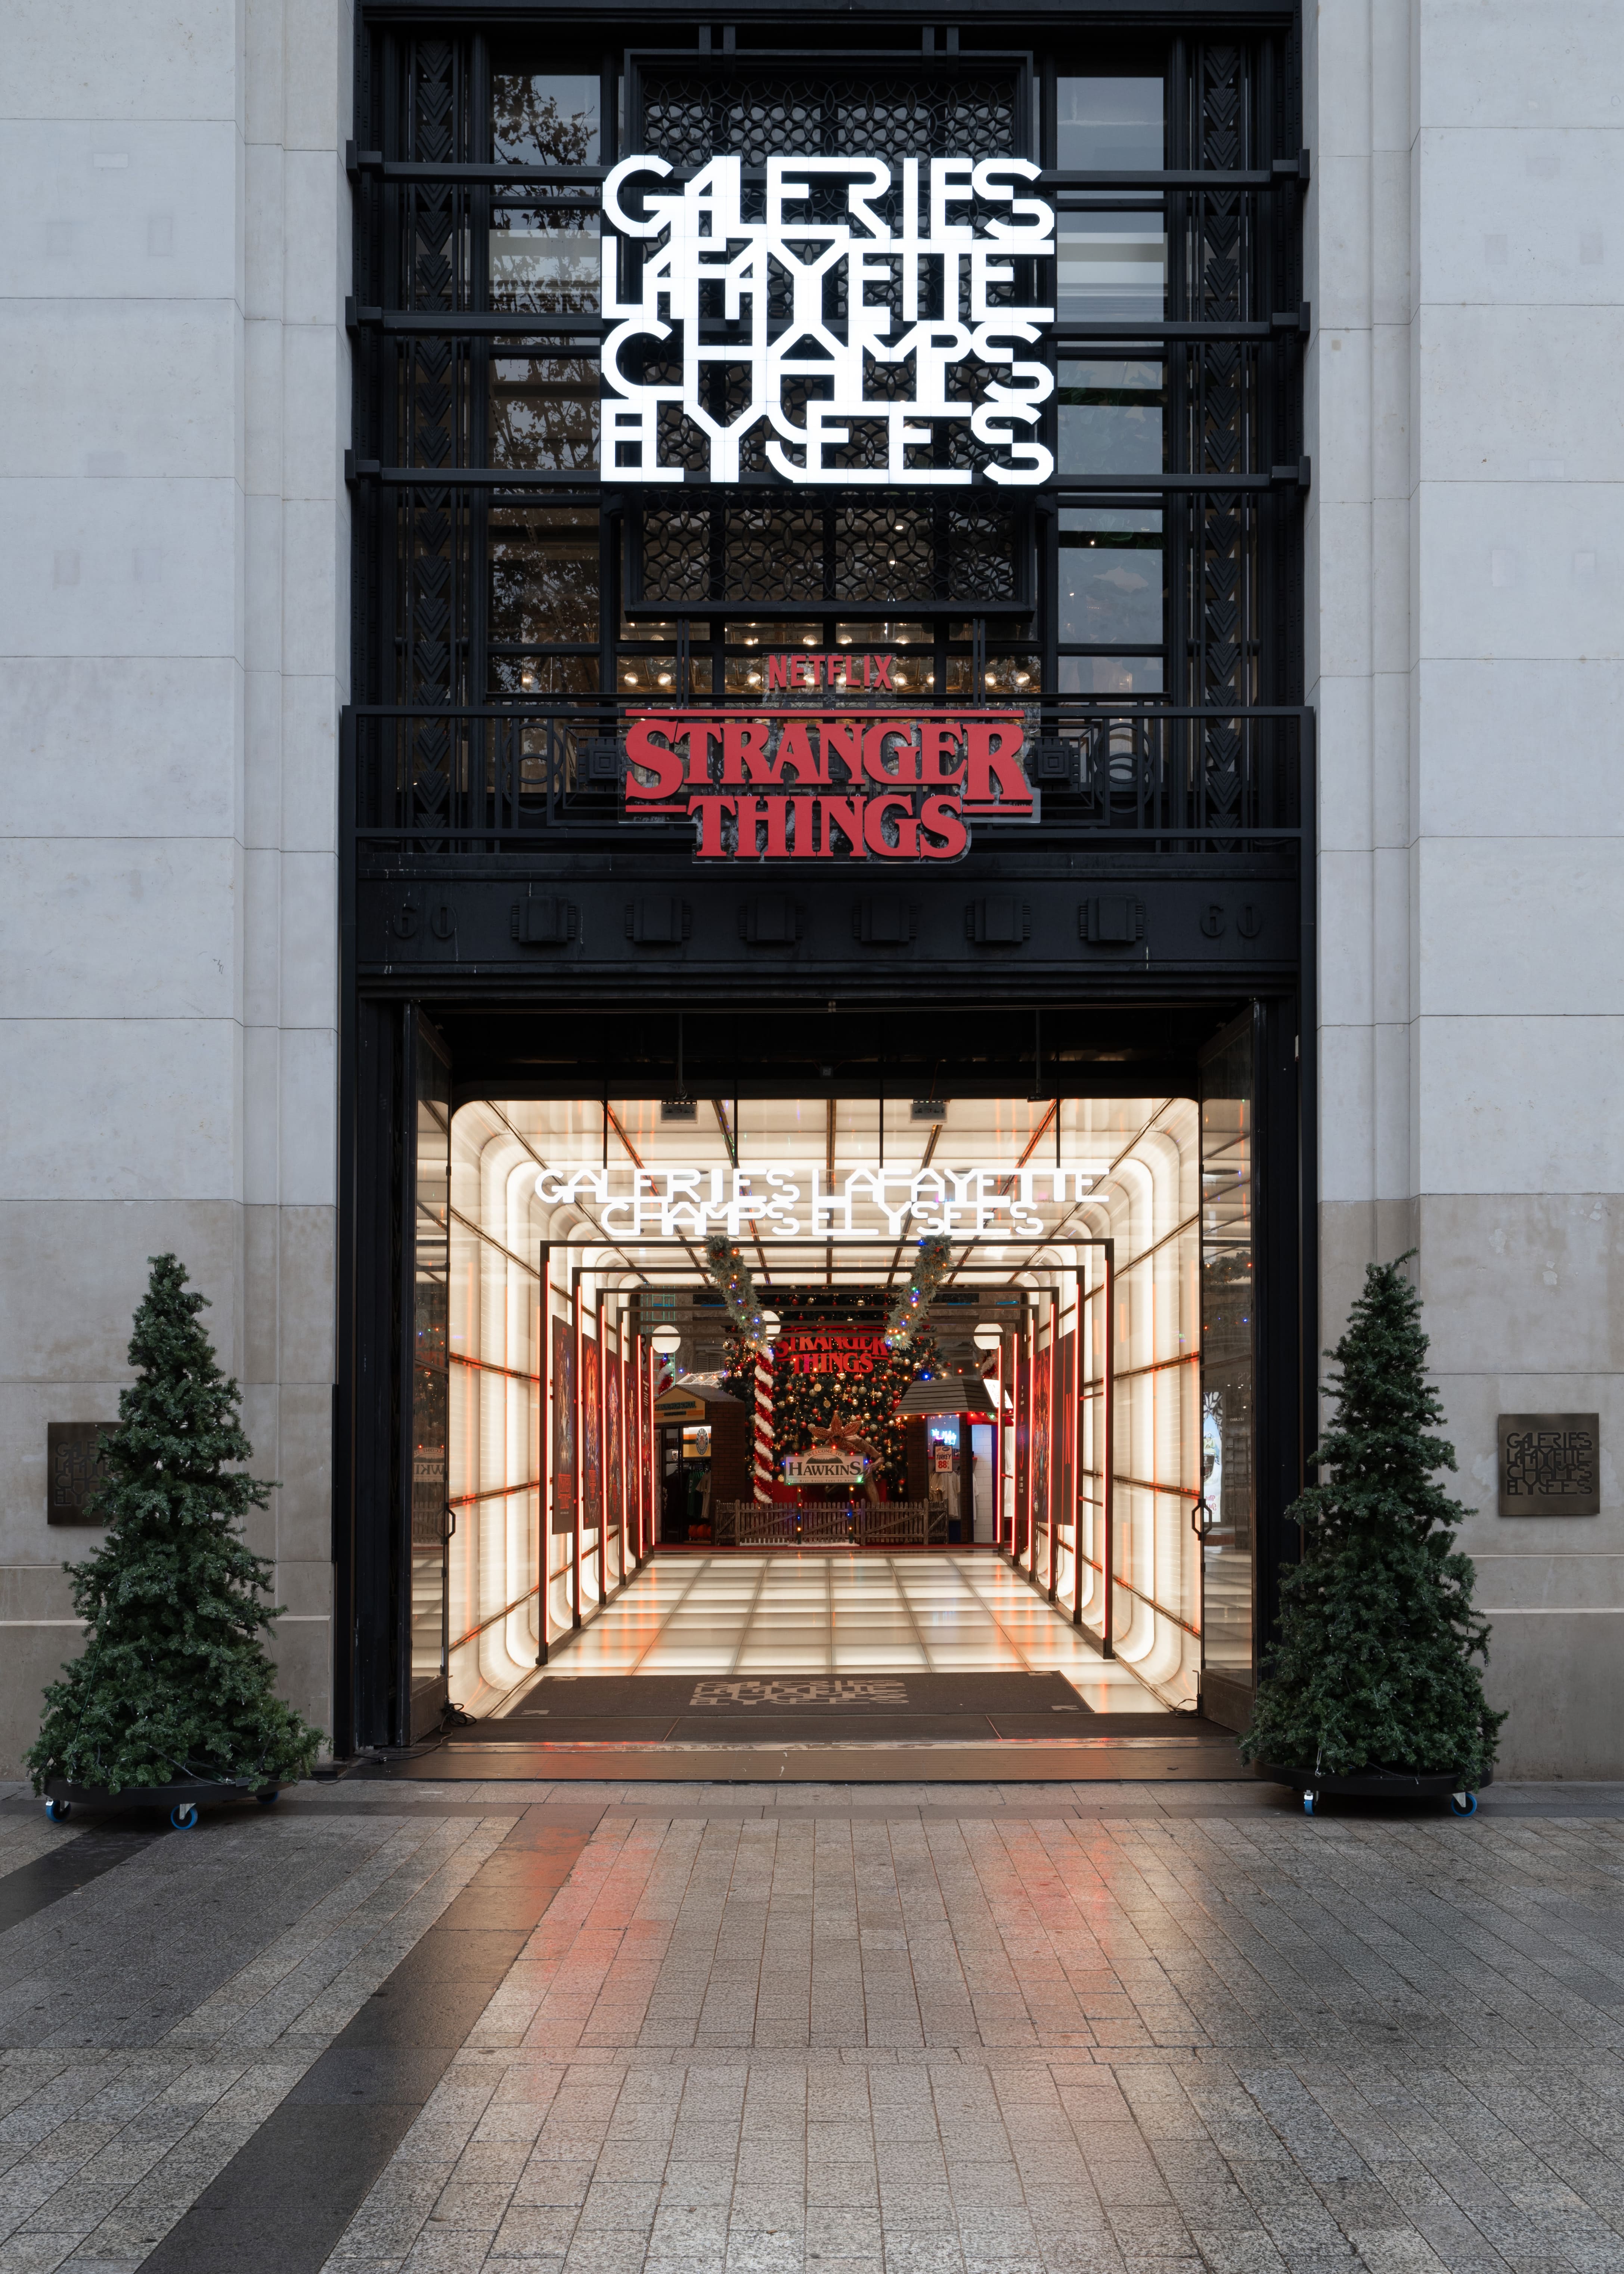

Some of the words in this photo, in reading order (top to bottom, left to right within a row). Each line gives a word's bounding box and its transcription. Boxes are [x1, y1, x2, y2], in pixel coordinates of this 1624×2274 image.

[602, 155, 1054, 240] GALERIES
[602, 236, 1054, 322] LAFAYETTE
[601, 319, 1054, 403] CHAMPS
[601, 399, 1054, 485] ELYSEES
[768, 655, 893, 691] NETFLIX
[625, 719, 1034, 802] STRANGER
[687, 794, 967, 859] THINGS
[535, 1168, 800, 1203] GALERIES
[812, 1168, 1109, 1203] LAFAYETTE
[601, 1201, 800, 1235] CHAMPS
[812, 1201, 1044, 1235] ELYSEES
[775, 1330, 889, 1358] STRANGER
[790, 1352, 874, 1374] THINGS
[1506, 1432, 1592, 1449] GALERIES
[1506, 1447, 1592, 1464] LAFAYETTE
[788, 1461, 861, 1476] HAWKINS
[1506, 1463, 1593, 1481] CHAMPS
